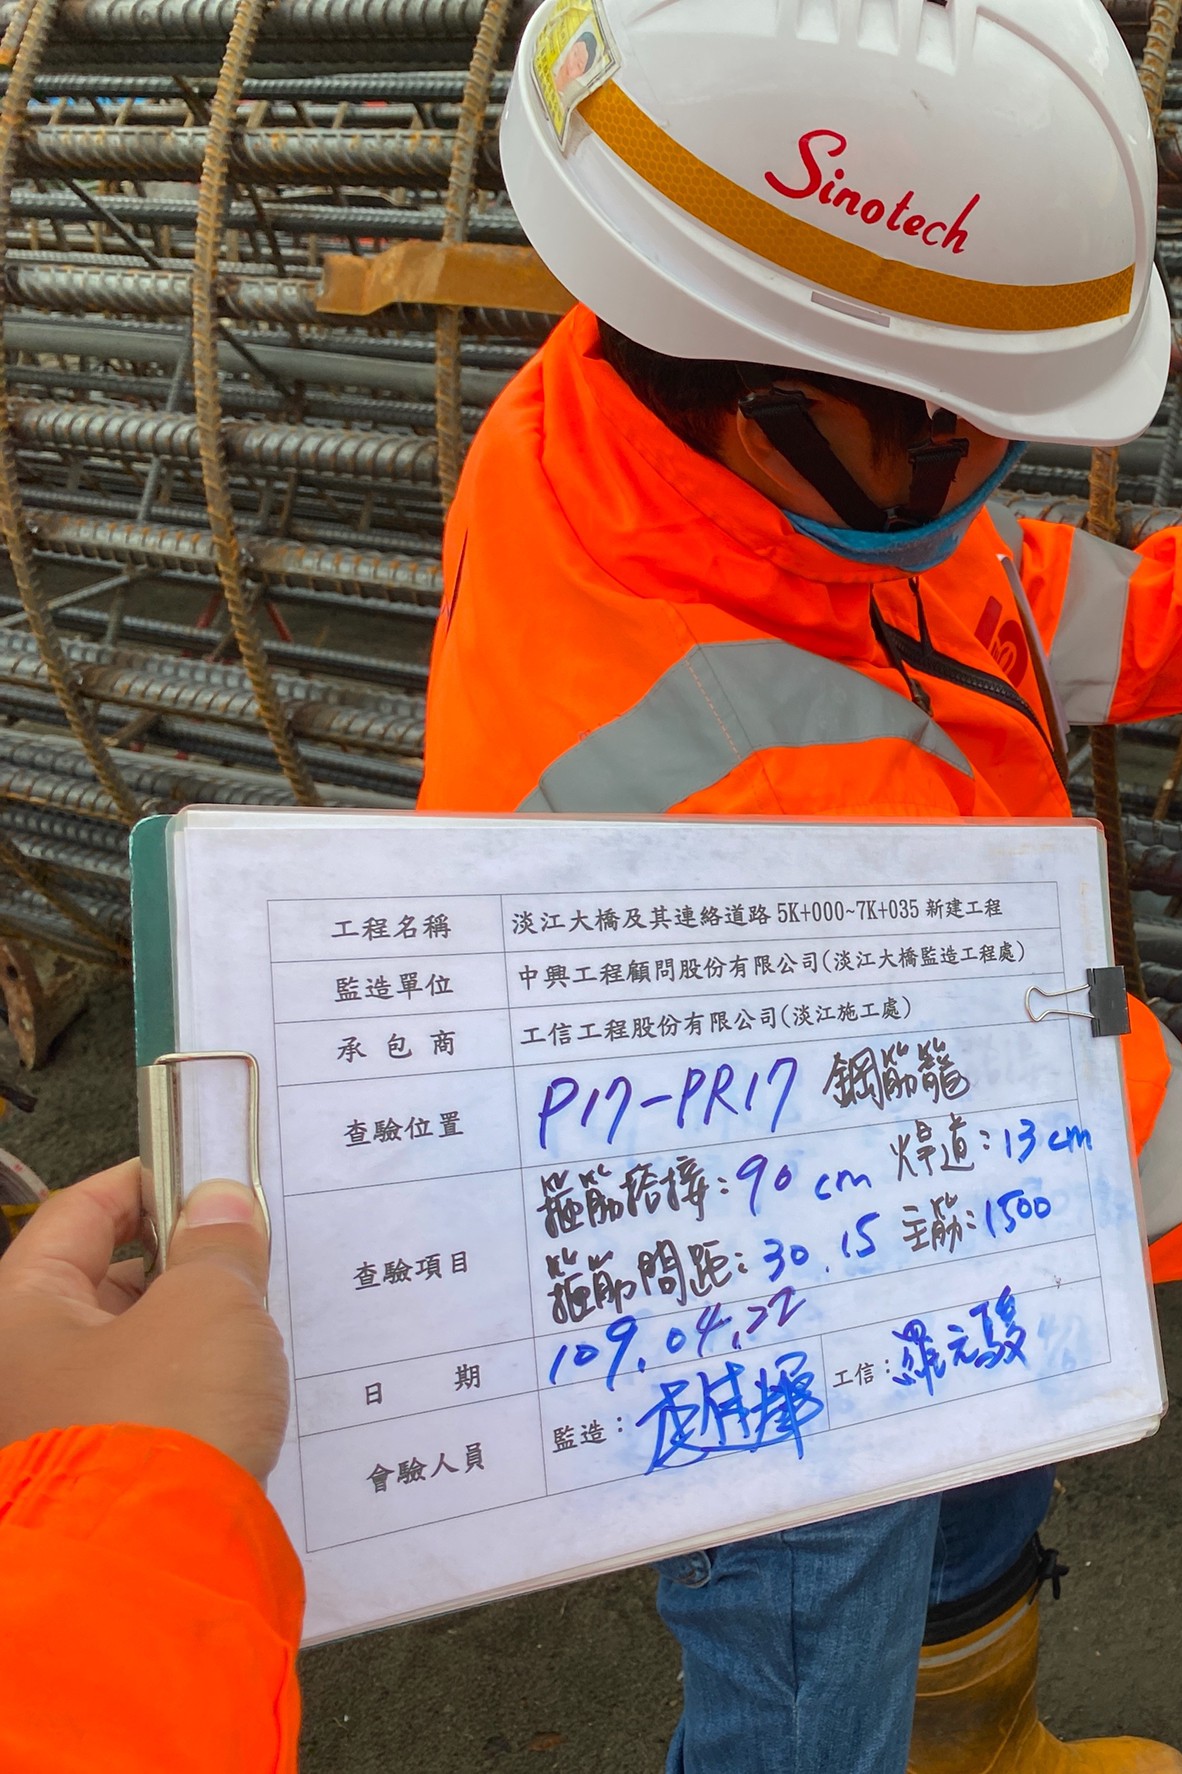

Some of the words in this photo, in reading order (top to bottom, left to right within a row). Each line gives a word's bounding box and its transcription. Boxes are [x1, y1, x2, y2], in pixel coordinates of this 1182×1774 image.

[763, 129, 981, 254] Sinotech
[331, 912, 453, 941] 工程名稱
[511, 904, 772, 935] 淡江大橋及其連絡道路
[776, 898, 920, 924] 5K+000~7K+035
[925, 898, 1003, 920] 新建工程
[518, 939, 1026, 987] 中興工程顧問股份有限公司(淡江大橋監造工程處)
[334, 972, 455, 1003] 監造單位
[521, 997, 913, 1047] 工信工程股份有限公司(淡江施工處)
[537, 1056, 799, 1150] P17-PR17
[344, 1111, 465, 1149] 查驗位置
[353, 1250, 469, 1291] 查驗項目
[367, 1441, 487, 1493] 會驗人員
